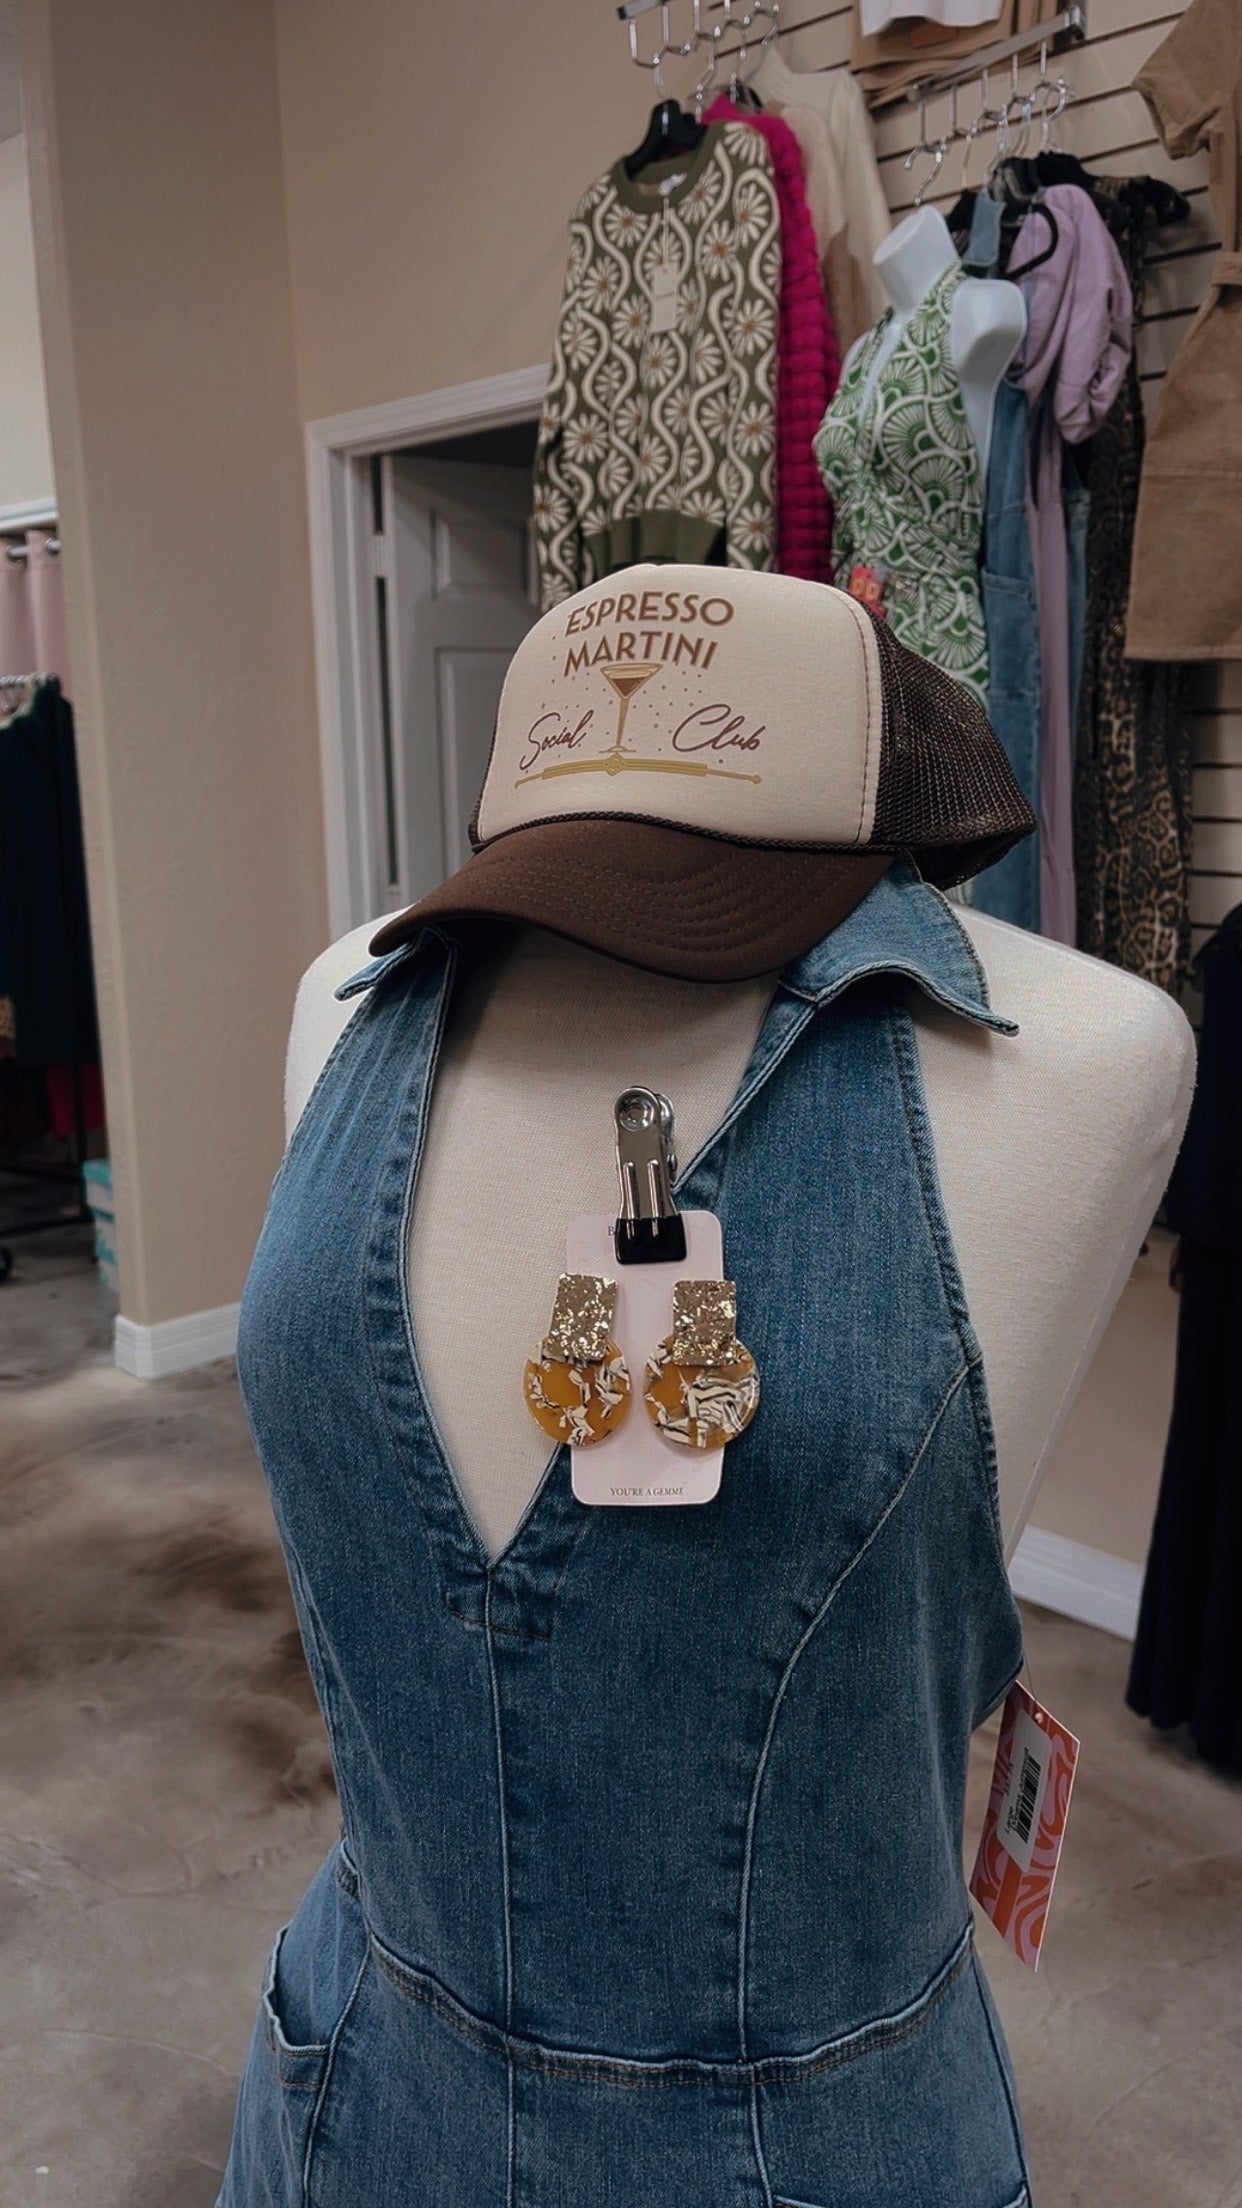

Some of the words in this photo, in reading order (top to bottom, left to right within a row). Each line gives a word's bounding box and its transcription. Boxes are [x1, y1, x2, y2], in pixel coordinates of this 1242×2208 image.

[564, 591, 734, 637] ESPRESSO
[563, 630, 718, 677] MARTINI
[519, 709, 594, 770] Social
[672, 703, 766, 752] Club
[645, 1487, 652, 1497] A
